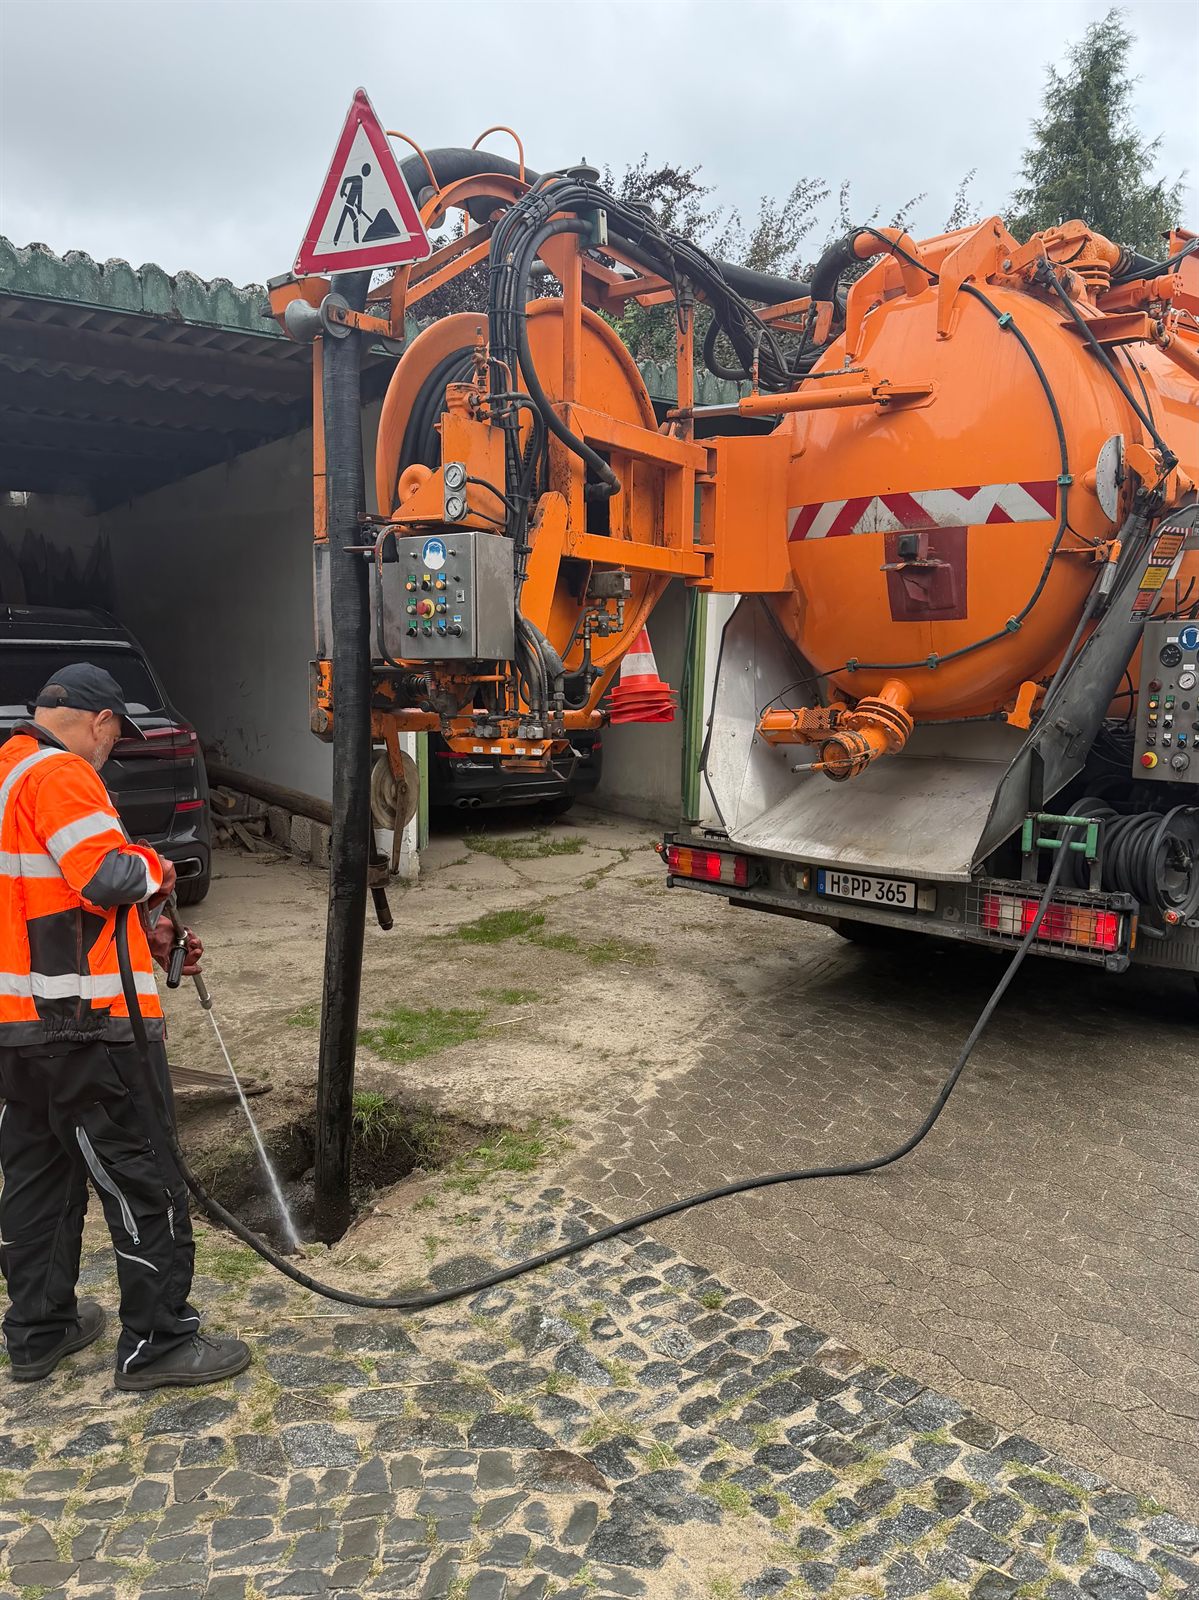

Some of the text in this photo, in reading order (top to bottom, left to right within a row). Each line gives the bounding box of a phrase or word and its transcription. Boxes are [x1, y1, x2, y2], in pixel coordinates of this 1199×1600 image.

[831, 874, 907, 903] H PP 365
